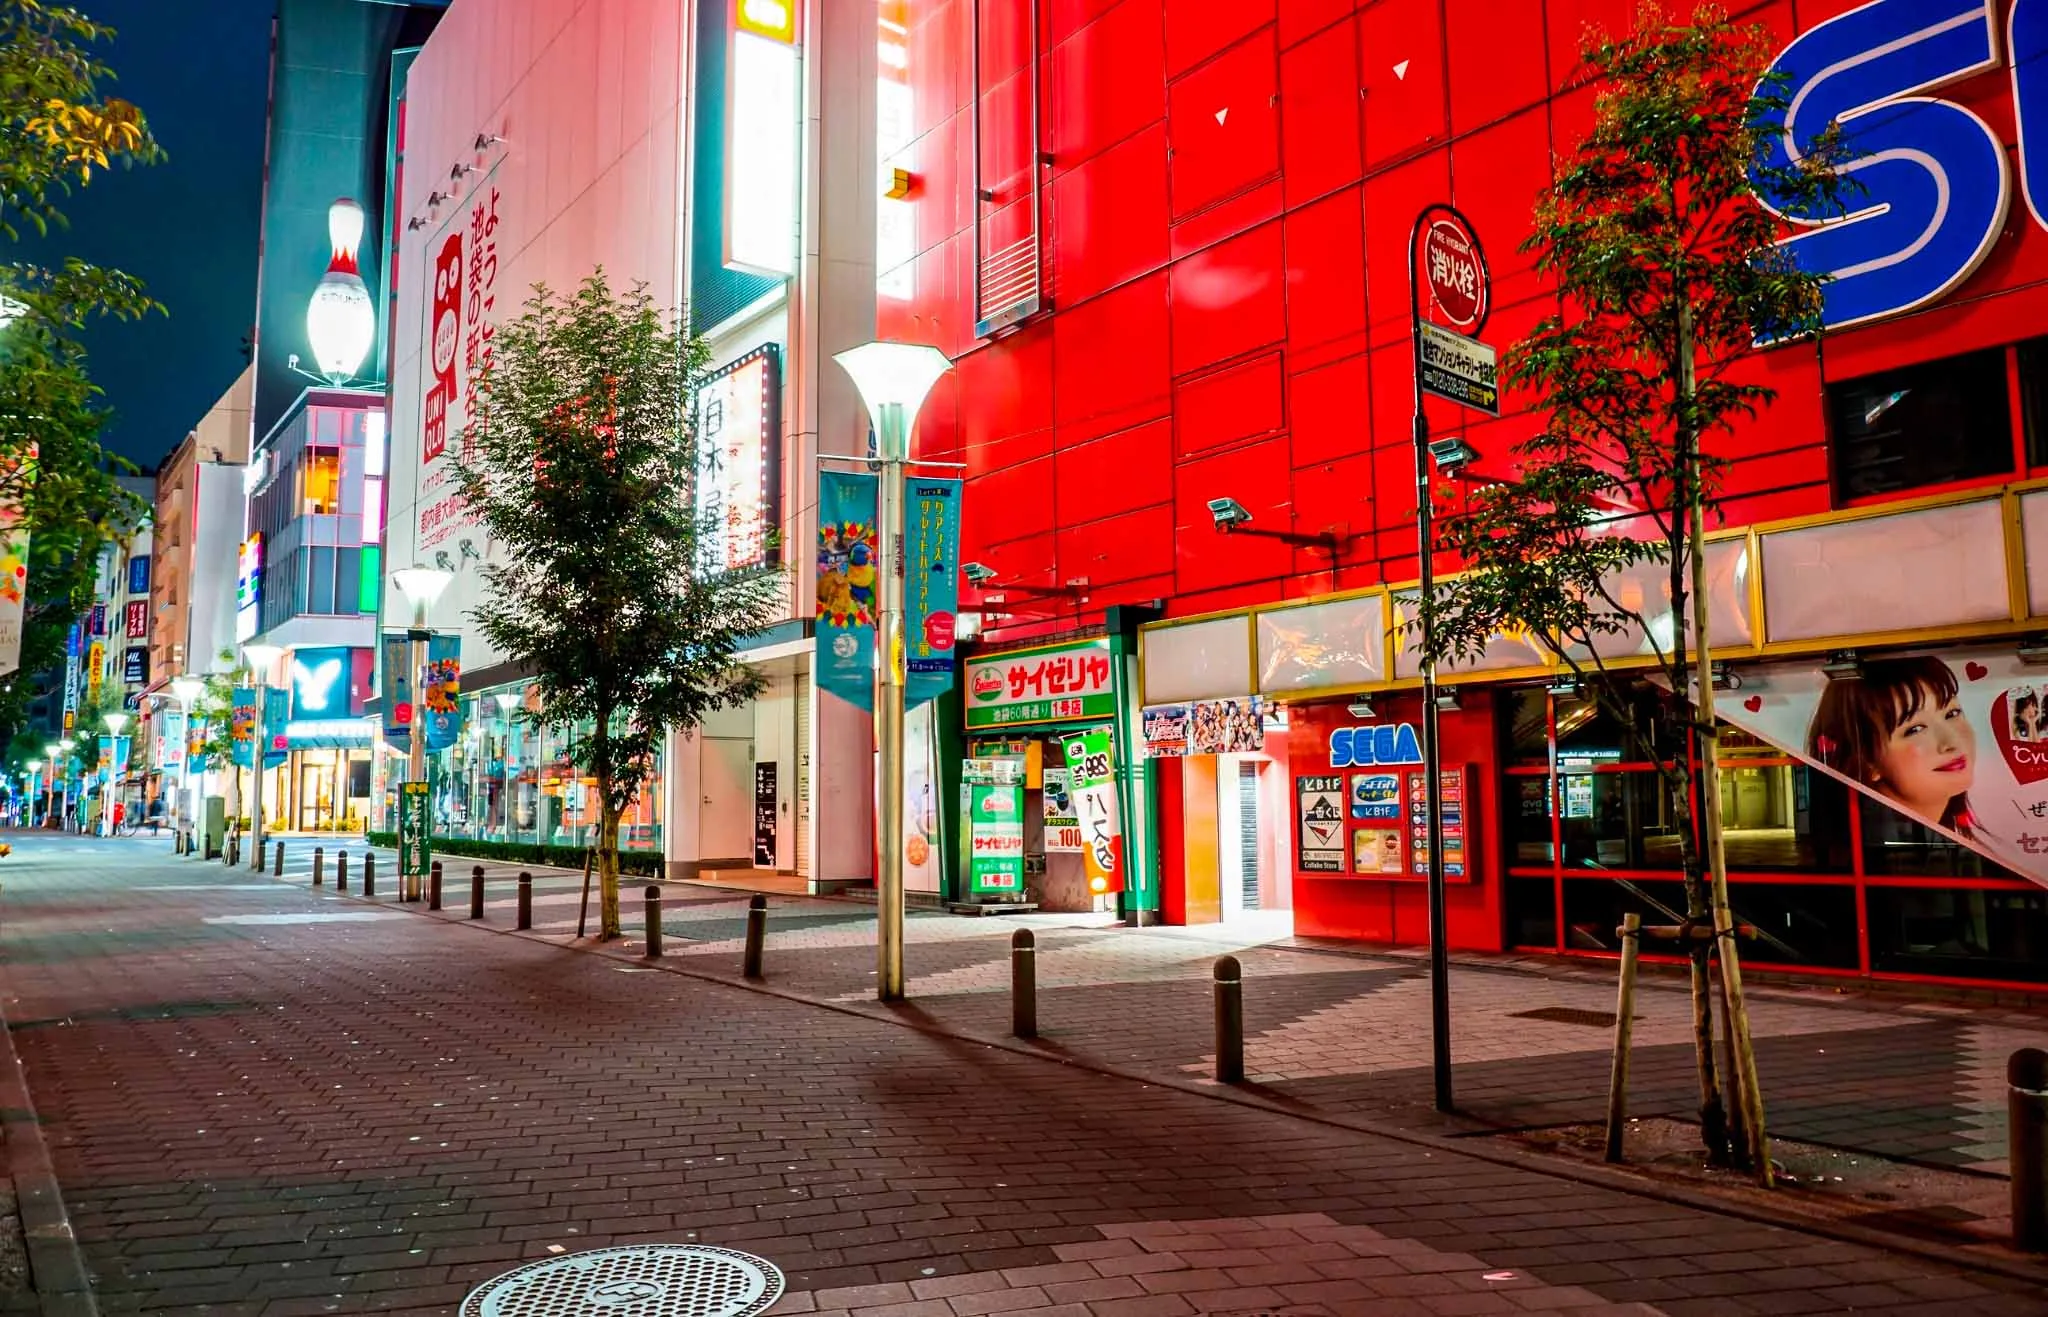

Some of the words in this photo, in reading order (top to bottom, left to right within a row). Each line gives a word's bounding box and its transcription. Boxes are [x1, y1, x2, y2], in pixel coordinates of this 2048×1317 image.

[1430, 244, 1476, 300] 消火栓
[427, 390, 443, 424] UNI
[425, 420, 443, 457] QLO
[704, 388, 725, 535] 白木屋
[1008, 655, 1109, 698] サイゼリヤ
[993, 703, 1048, 722] 池袋60階通り
[1052, 699, 1082, 718] 1号店
[1330, 723, 1425, 767] SEGA
[1316, 777, 1342, 790] B1F
[1361, 780, 1396, 790] SEGA
[1374, 806, 1391, 815] B1F
[974, 837, 1021, 849] サイゼリヤ
[1058, 828, 1082, 847] 100
[982, 874, 1013, 886] 1号店
